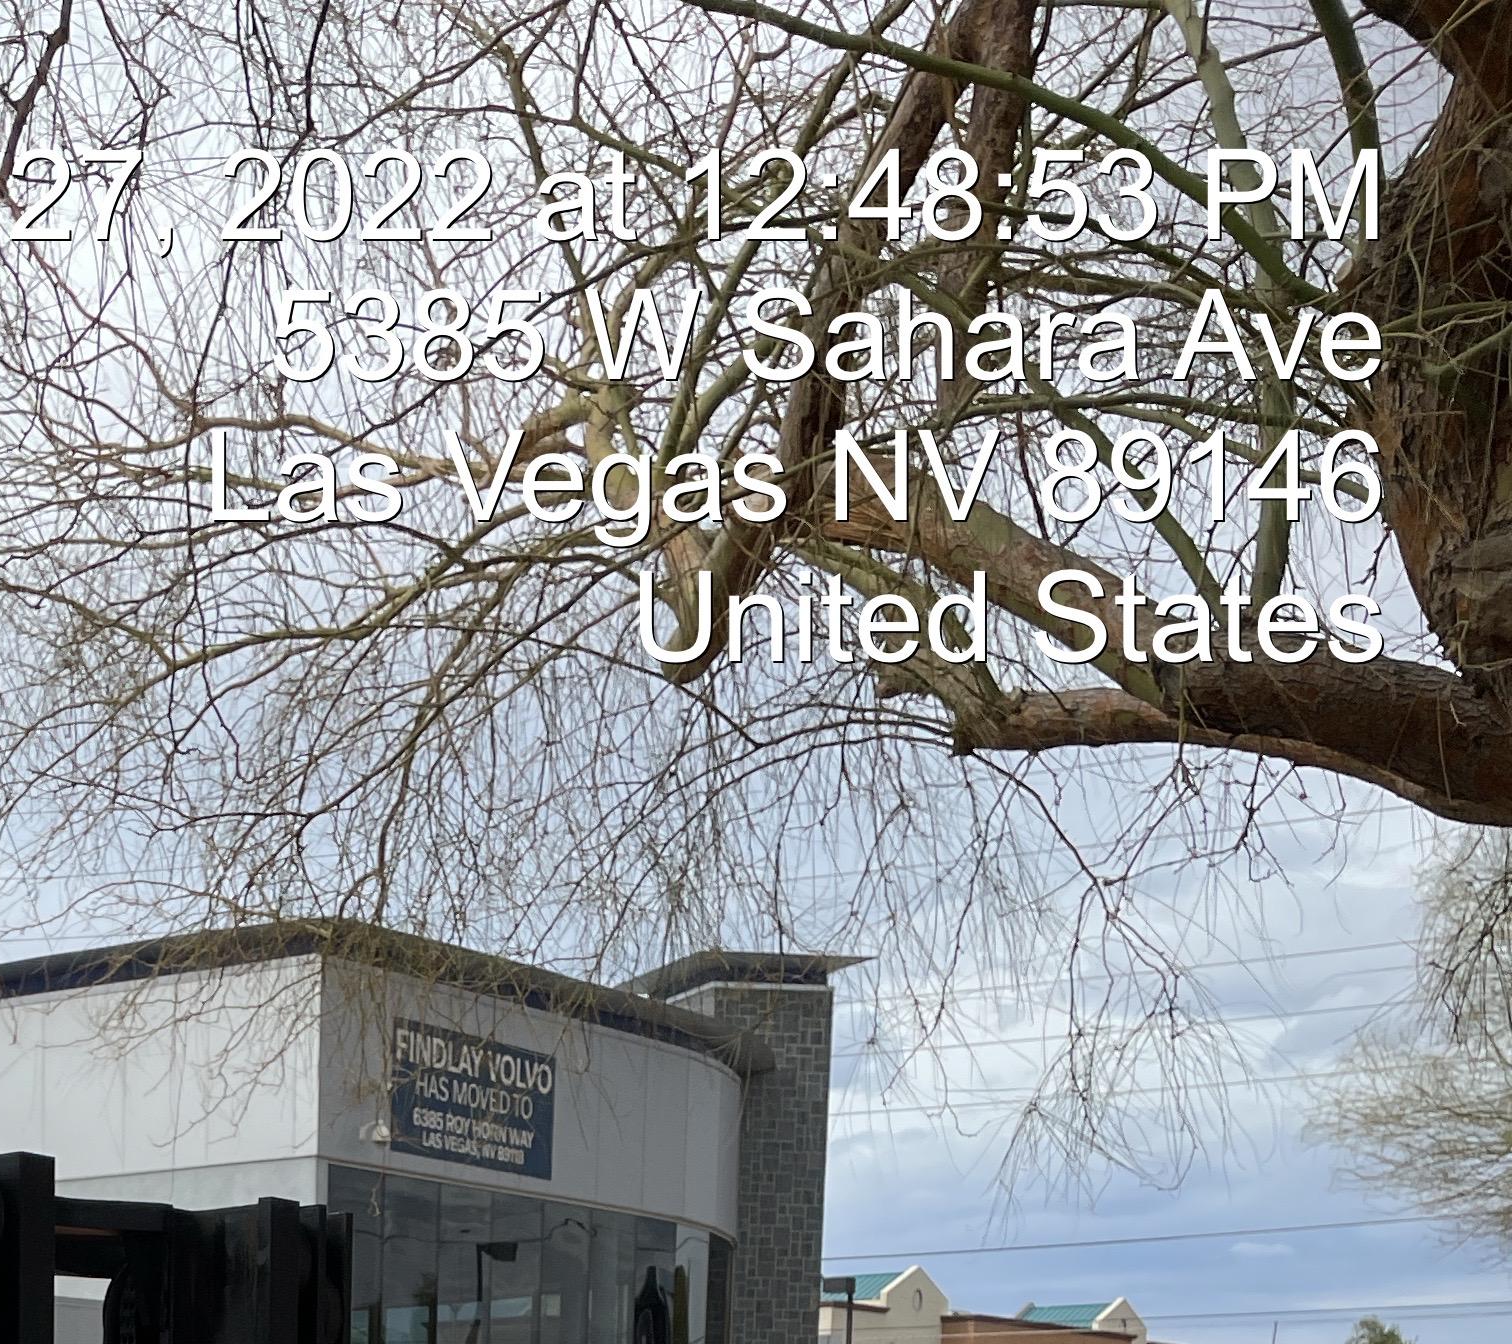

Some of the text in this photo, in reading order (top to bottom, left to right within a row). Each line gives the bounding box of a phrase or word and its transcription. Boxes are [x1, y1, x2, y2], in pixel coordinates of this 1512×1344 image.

[396, 1029, 553, 1095] FINDLAY VOLVO
[415, 1072, 534, 1120] HAS MOVED TO
[421, 1130, 443, 1149] LAS
[445, 1112, 471, 1136] ROY
[508, 1126, 535, 1150] WAY
